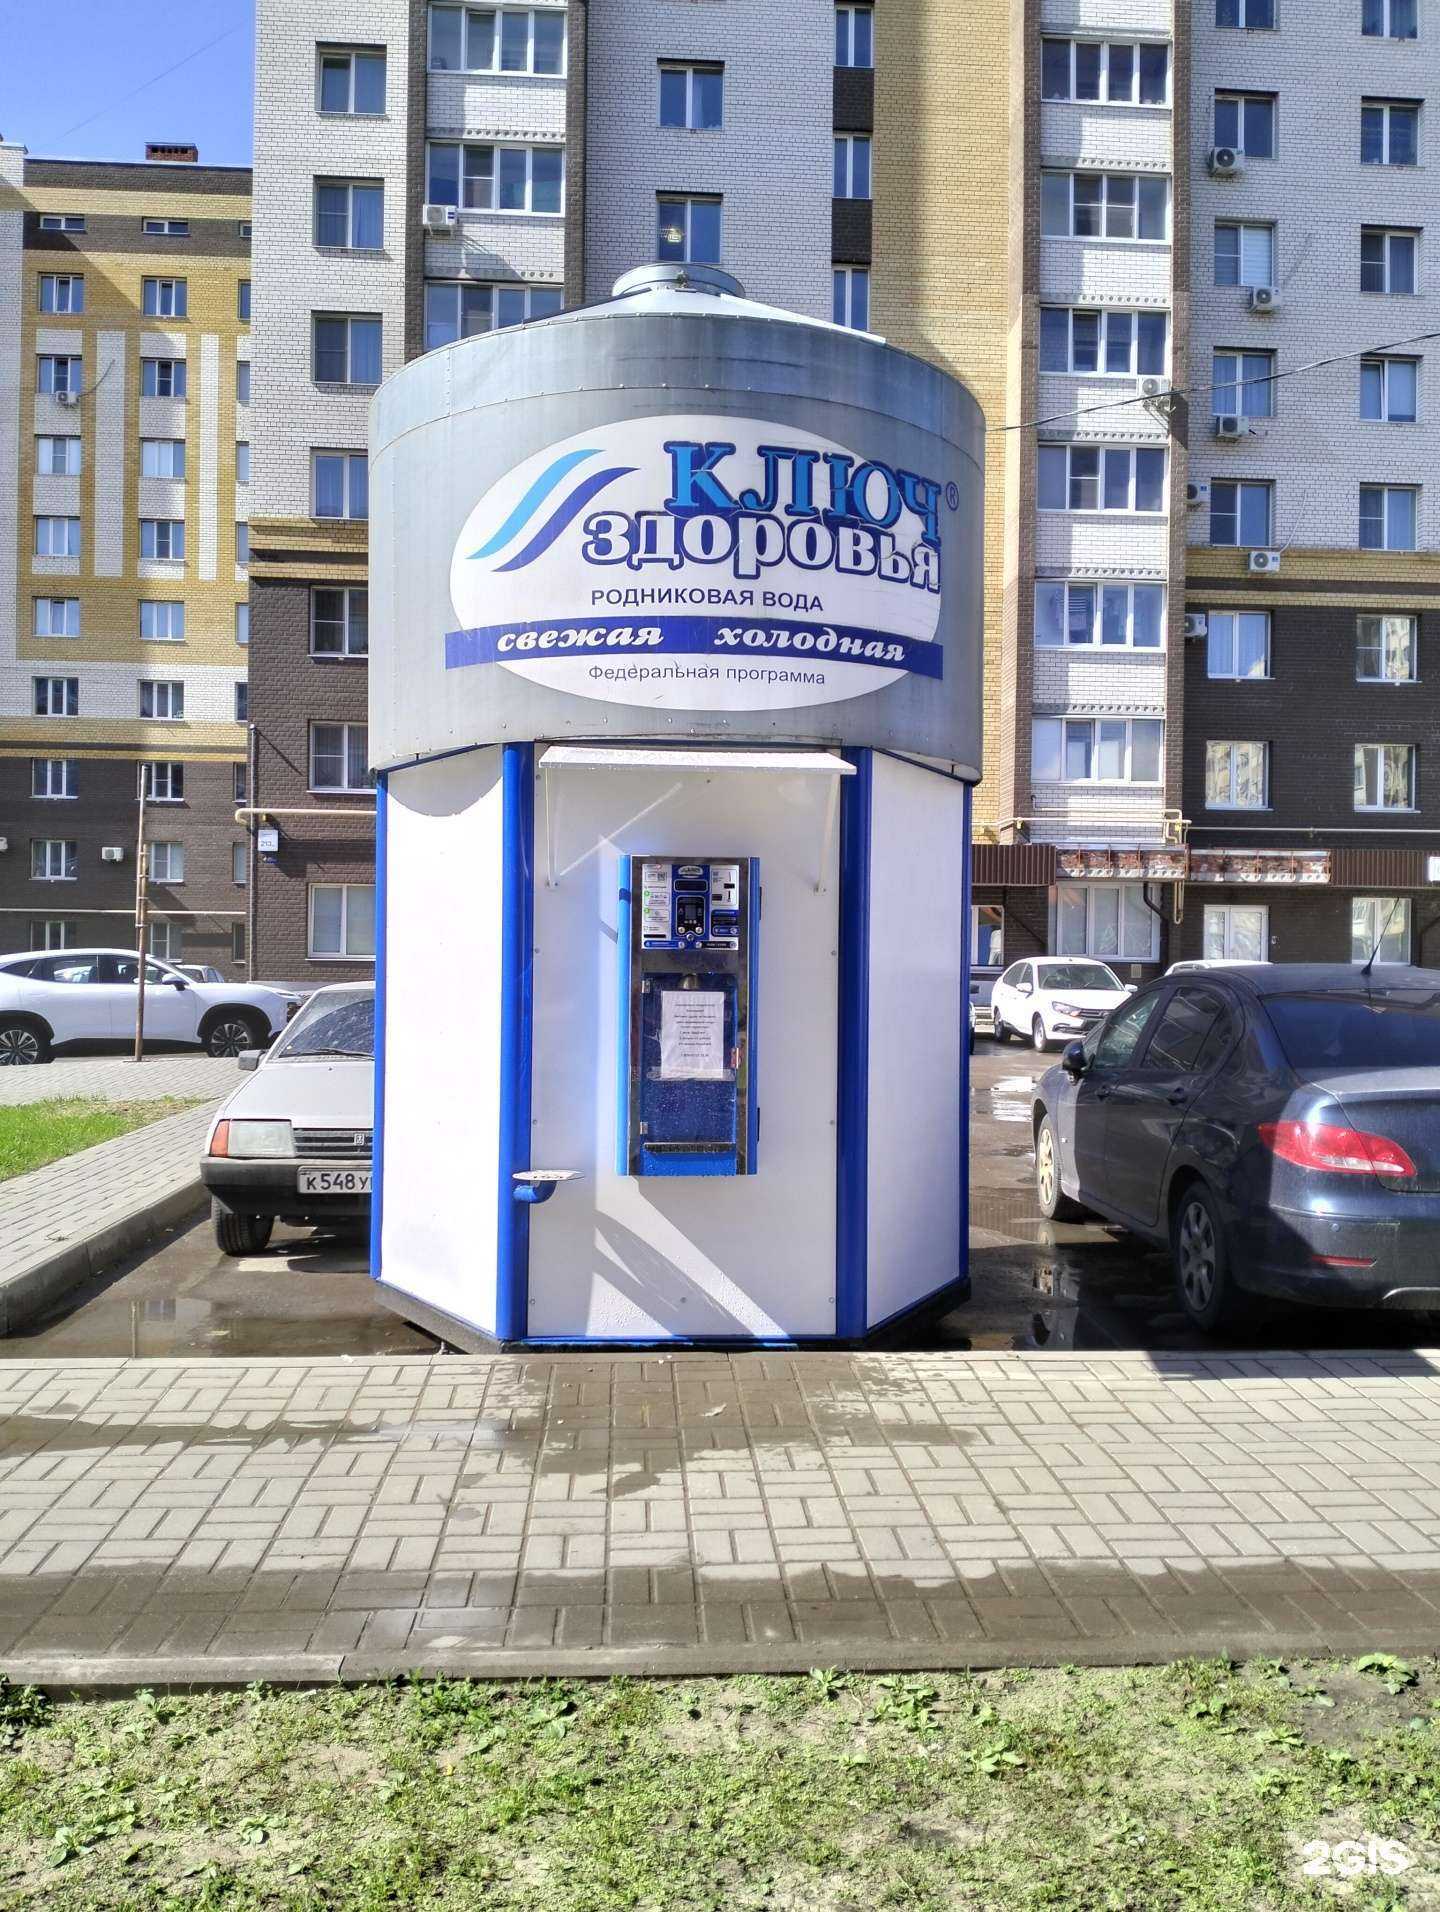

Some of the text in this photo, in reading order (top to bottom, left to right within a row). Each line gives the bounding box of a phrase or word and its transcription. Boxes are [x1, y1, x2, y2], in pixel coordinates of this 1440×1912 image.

[591, 588, 824, 612] РОДНИКОВАЯ ВОДА
[498, 624, 906, 663] свежая холодная
[588, 663, 825, 686] Федеральная программа
